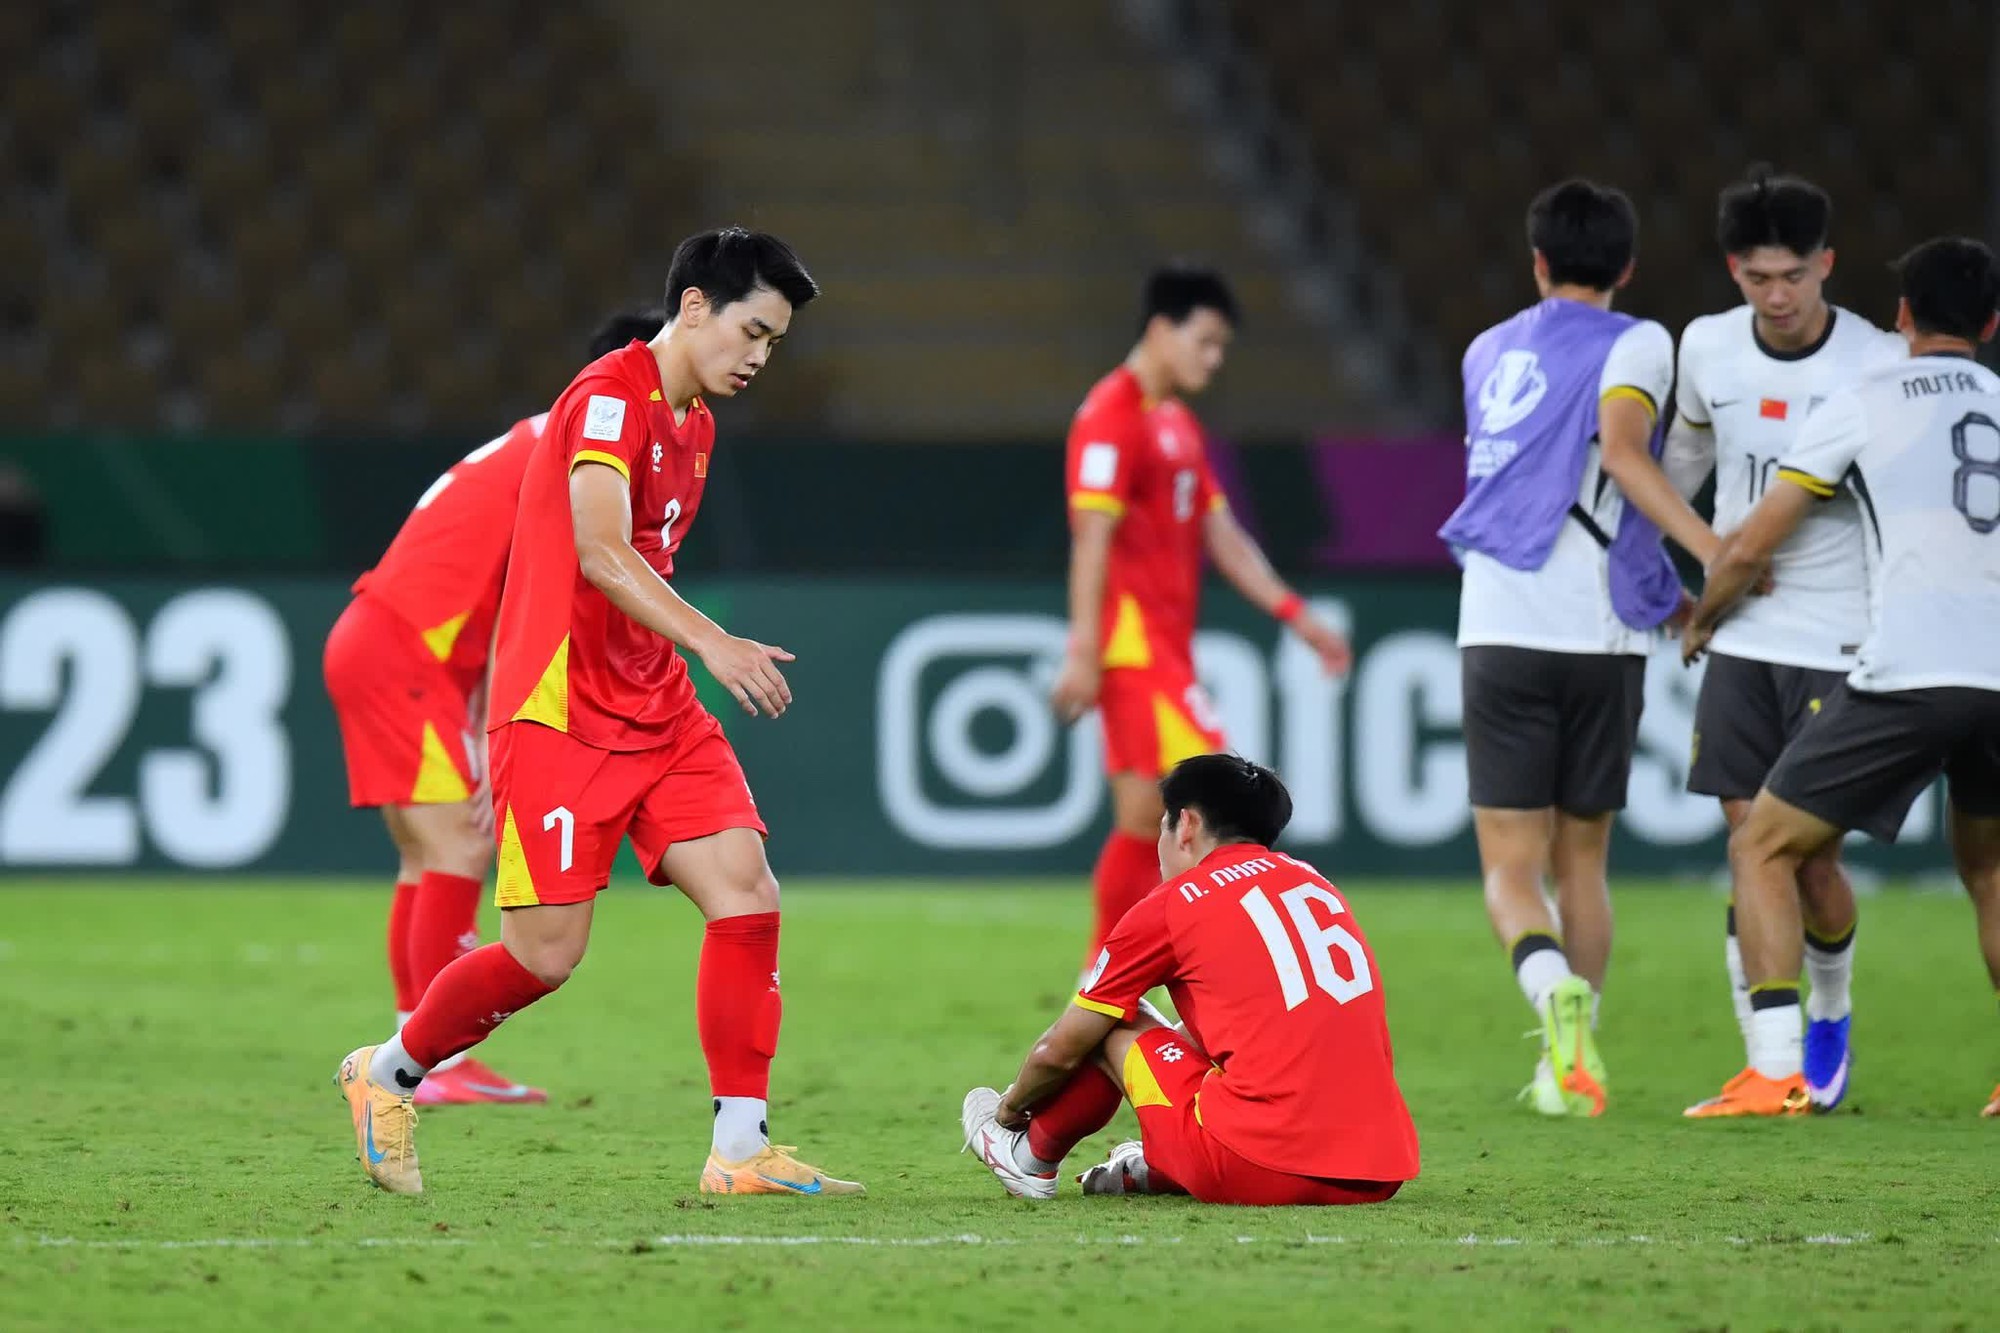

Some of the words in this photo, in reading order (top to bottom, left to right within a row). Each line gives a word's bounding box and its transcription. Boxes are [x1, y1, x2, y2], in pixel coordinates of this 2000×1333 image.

[1952, 412, 2000, 533] 8
[0, 587, 293, 868] 23
[542, 805, 575, 873] 7
[1239, 881, 1374, 1012] 16
